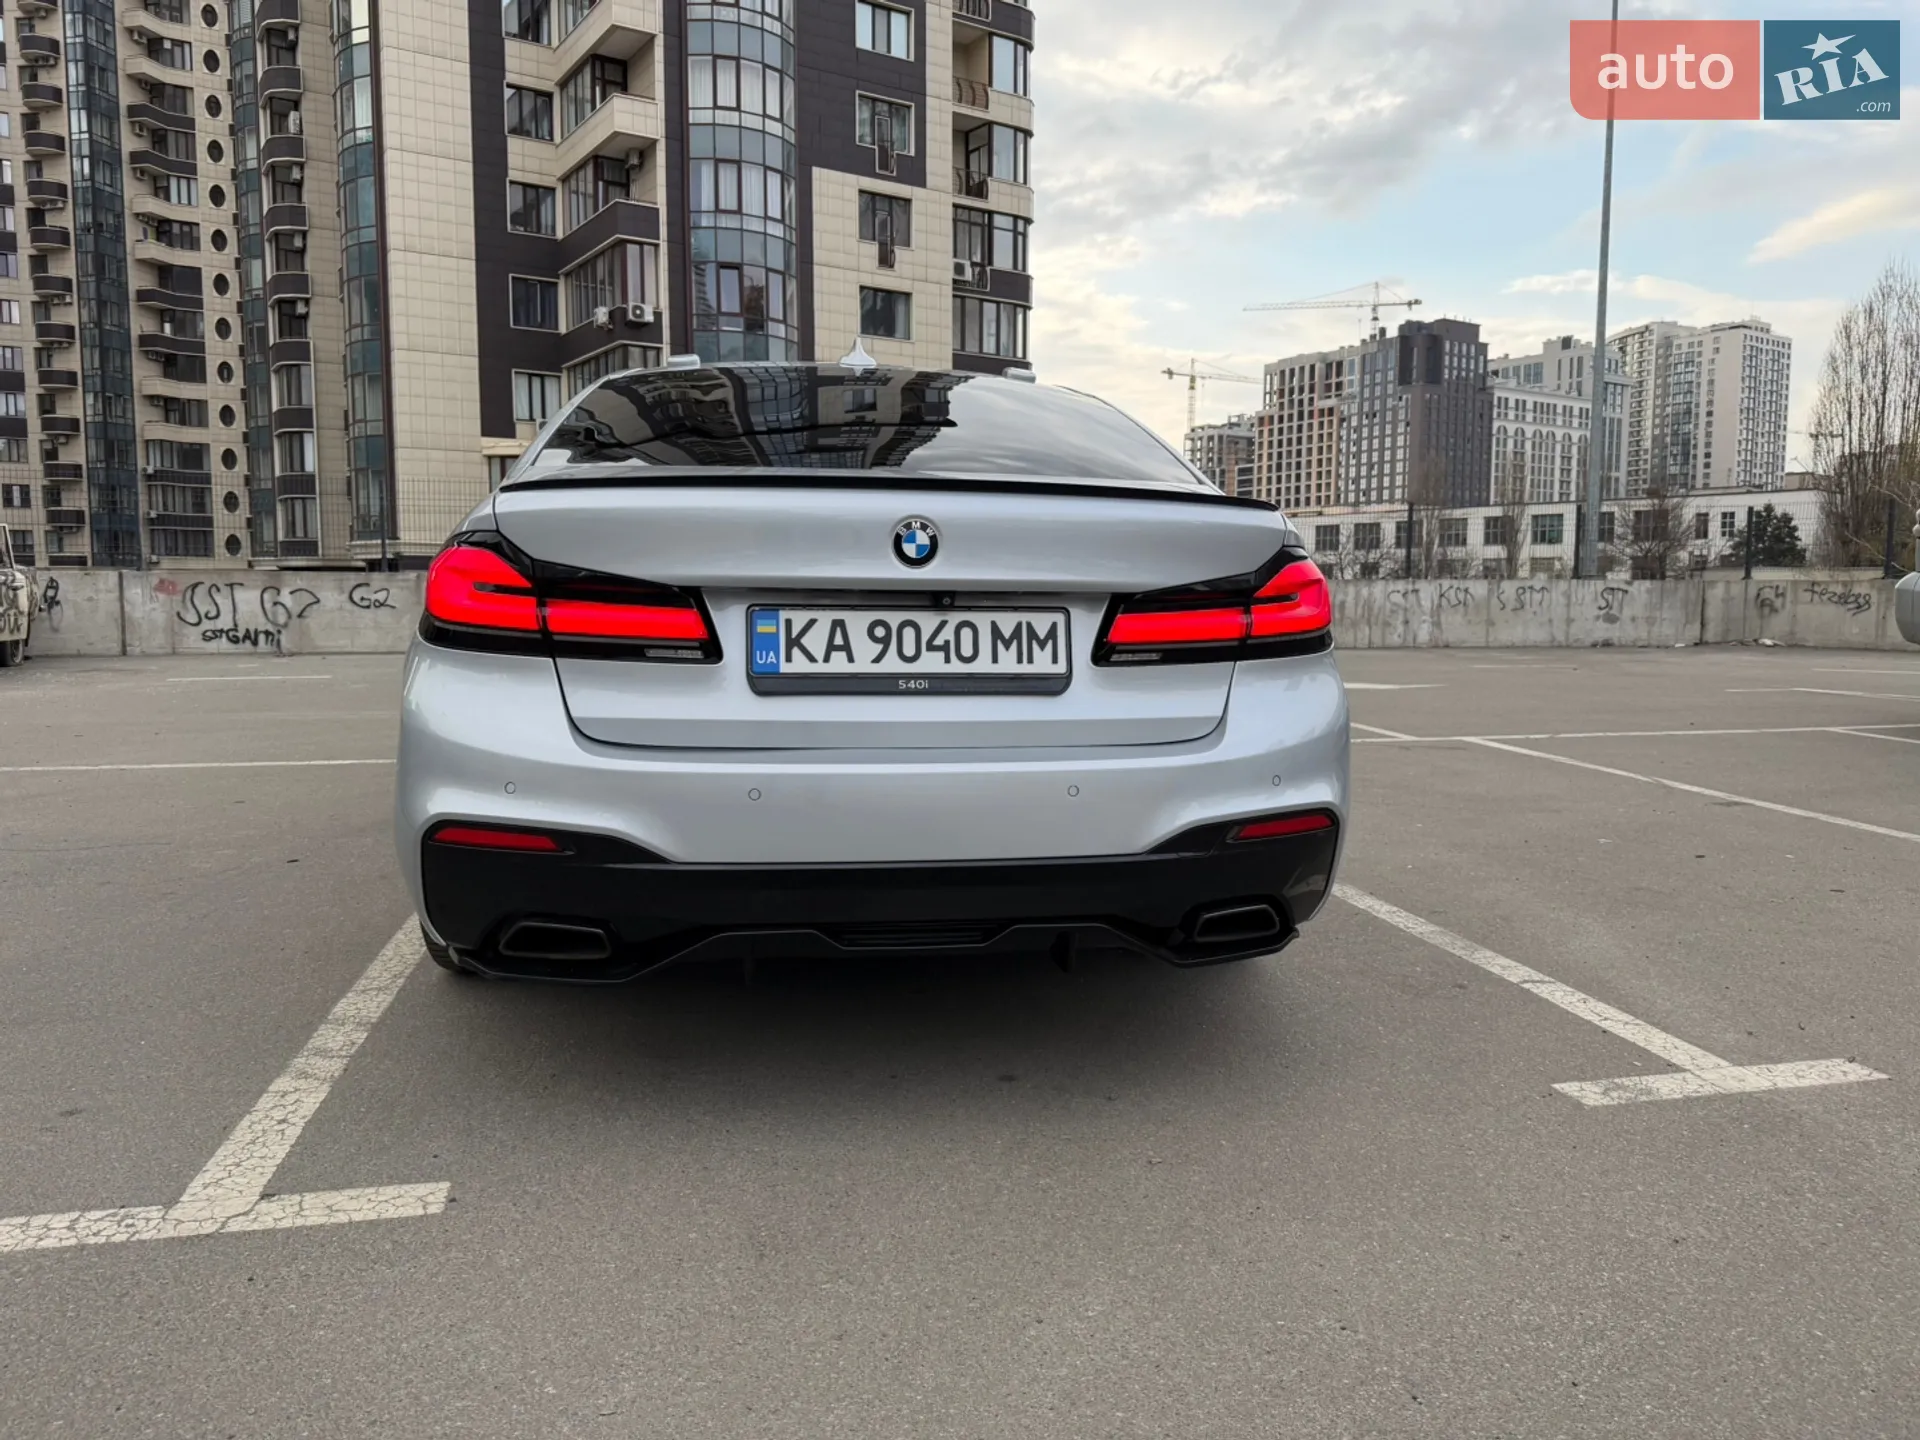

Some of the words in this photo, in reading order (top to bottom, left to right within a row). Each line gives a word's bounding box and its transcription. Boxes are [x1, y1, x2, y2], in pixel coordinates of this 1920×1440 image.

[897, 520, 936, 537] BMW
[784, 618, 855, 663] KA
[866, 618, 979, 664] 9040
[990, 619, 1058, 664] MM
[756, 651, 777, 664] UA
